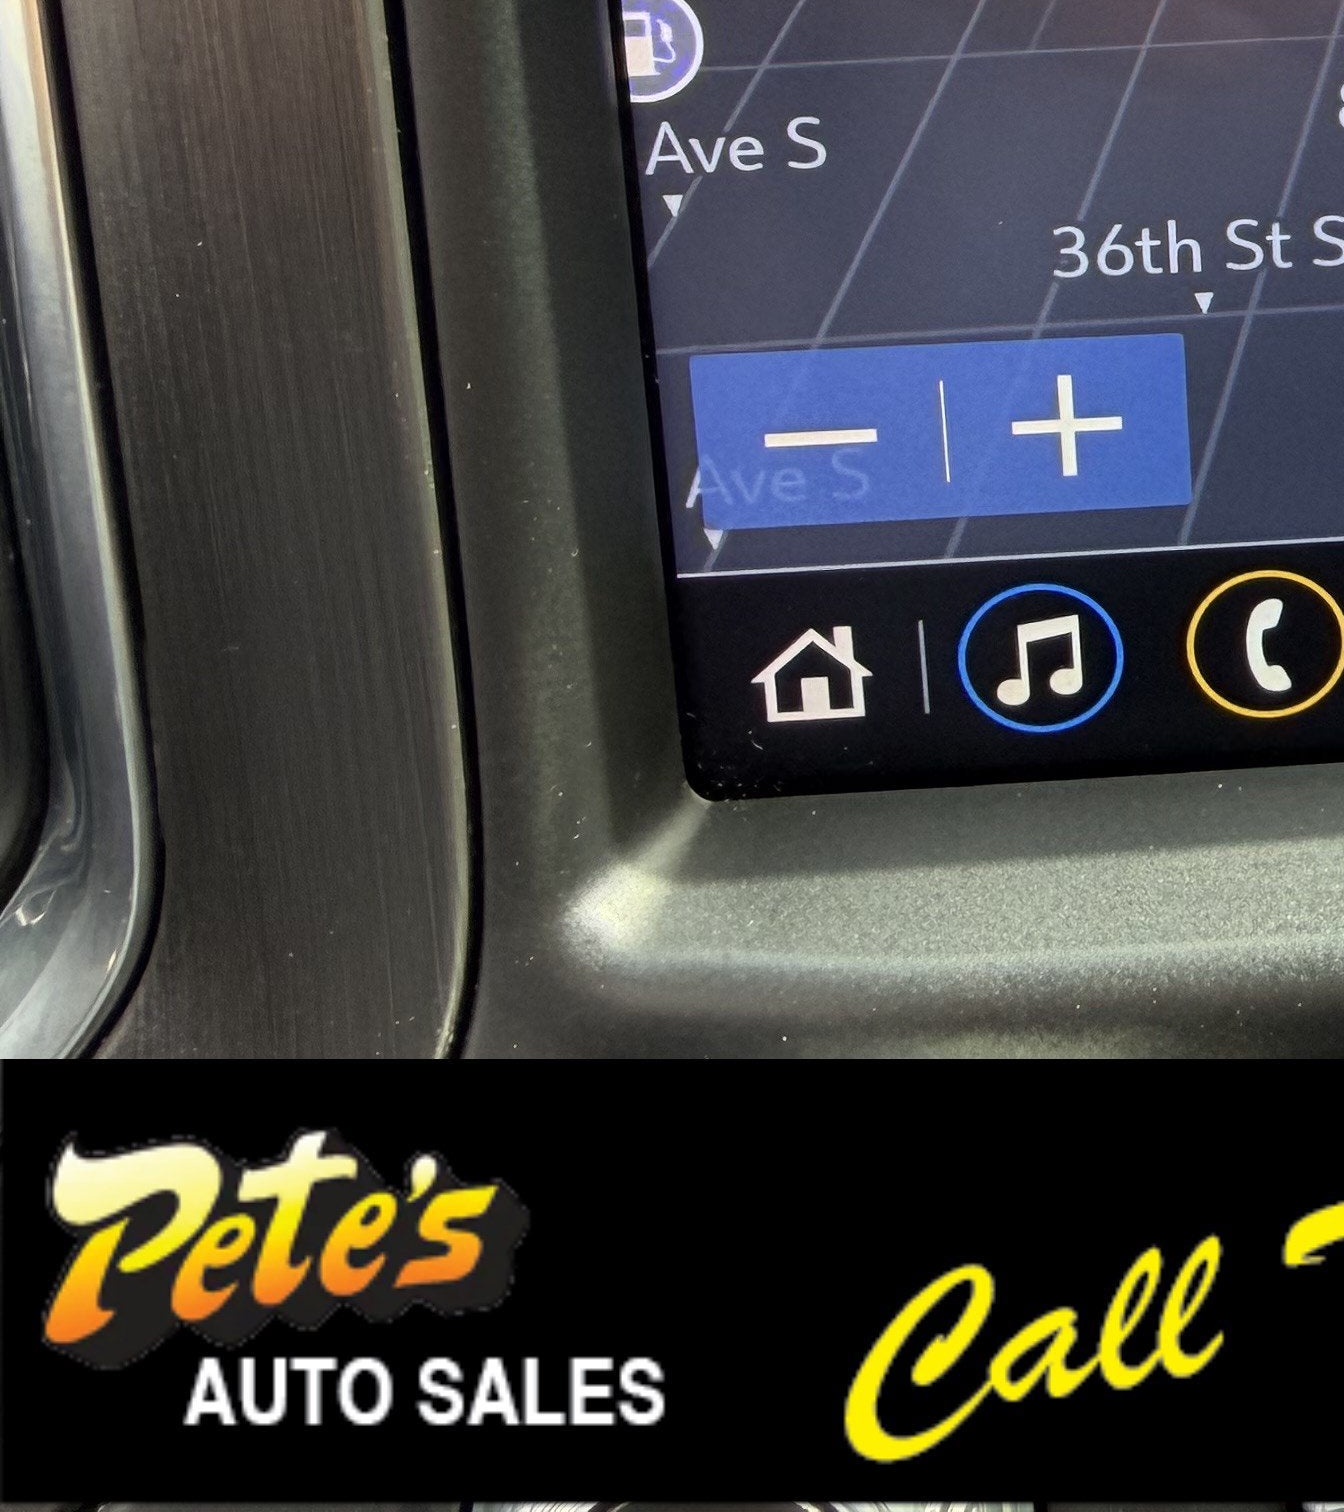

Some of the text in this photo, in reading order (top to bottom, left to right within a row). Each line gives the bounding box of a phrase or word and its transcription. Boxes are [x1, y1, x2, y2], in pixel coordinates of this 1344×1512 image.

[645, 116, 827, 176] Ave S
[1053, 219, 1202, 278] 36th
[1225, 218, 1293, 271] St
